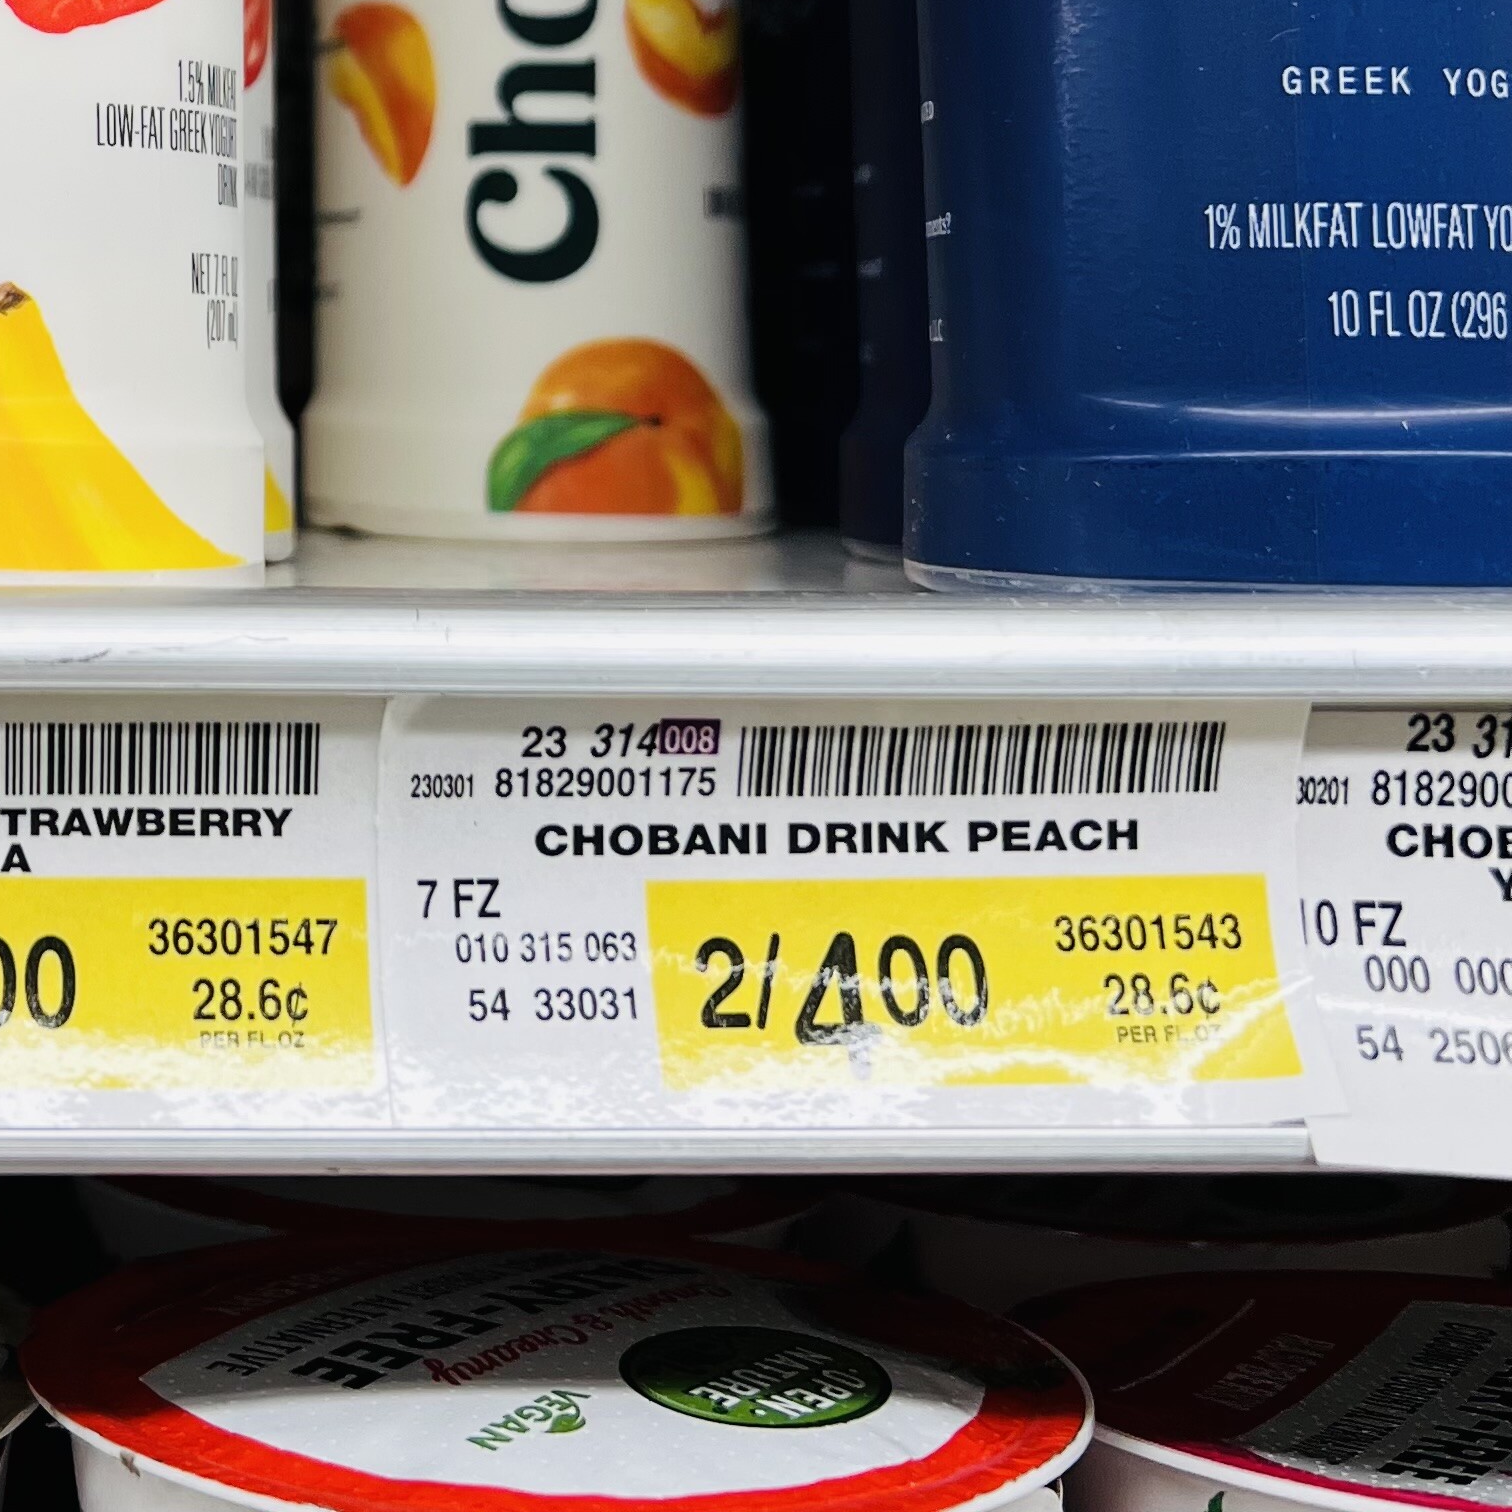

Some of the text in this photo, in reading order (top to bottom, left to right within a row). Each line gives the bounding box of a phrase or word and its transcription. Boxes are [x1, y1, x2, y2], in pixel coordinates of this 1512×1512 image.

[1282, 65, 1412, 96] GREEK
[96, 101, 165, 150] LOW-FAT
[1204, 201, 1480, 250] 1% MILKFAT LOWFAT
[1328, 289, 1510, 340] 10 FL OZ (296
[521, 726, 567, 758] 23
[1407, 712, 1456, 753] 23
[410, 766, 717, 798] 230301 81829001175
[534, 819, 1139, 856] CHOBANI DRINK PEACH
[417, 879, 501, 919] 7 FZ
[148, 918, 339, 956] 36301547
[1054, 913, 1243, 952] 36301543
[1354, 899, 1407, 948] FZ
[456, 932, 638, 963] 010 315 063
[1364, 954, 1431, 994] 000
[193, 977, 309, 1028] 28.6¢
[468, 988, 638, 1021] 54 33031
[200, 1029, 241, 1049] PER
[1117, 1025, 1158, 1044] PER
[1356, 1024, 1404, 1062] 54
[686, 1344, 833, 1411] NATURE
[755, 1366, 867, 1420] OPEN
[466, 1388, 592, 1451] VEGAN
